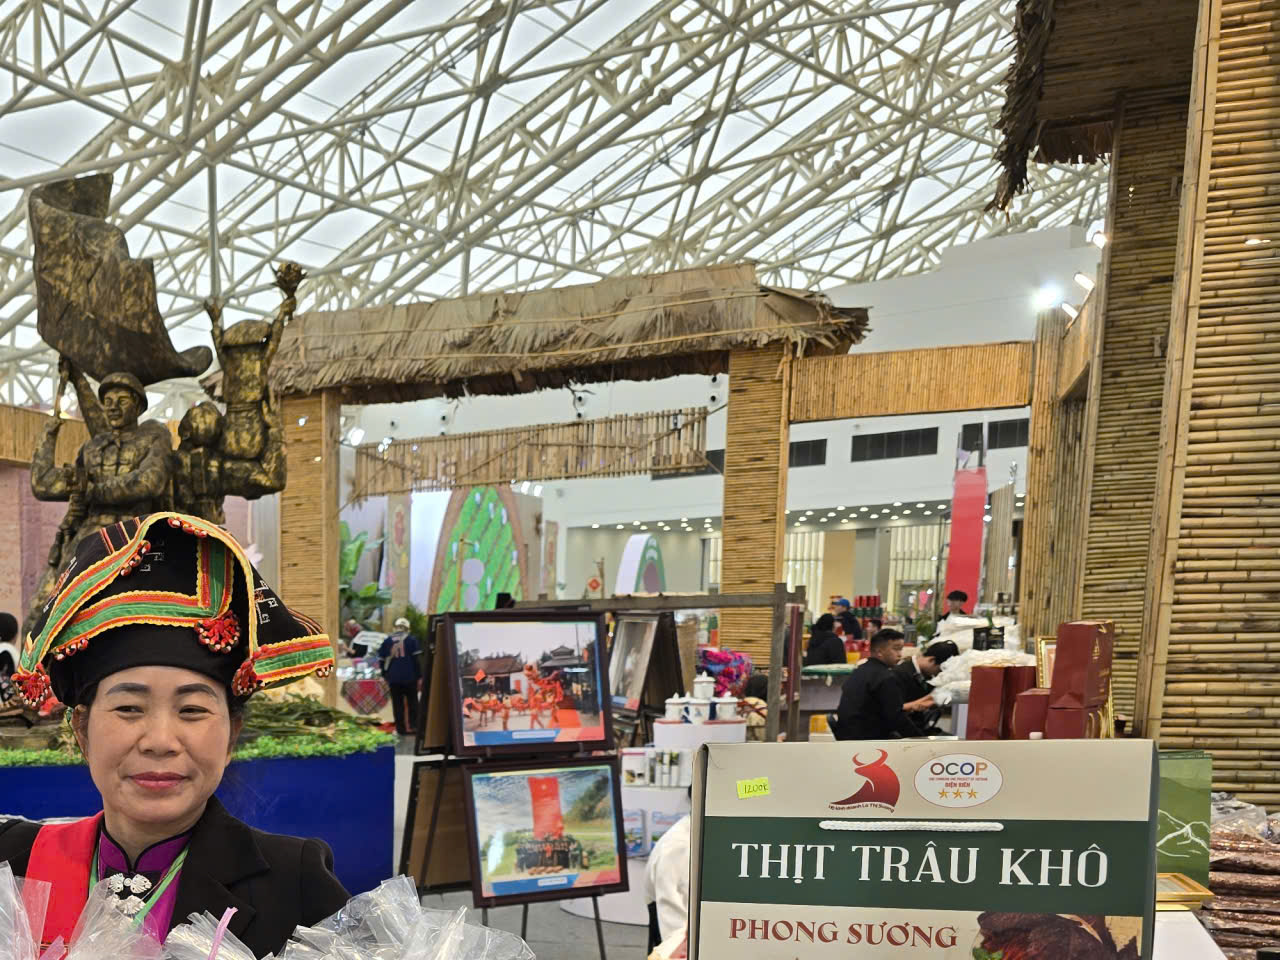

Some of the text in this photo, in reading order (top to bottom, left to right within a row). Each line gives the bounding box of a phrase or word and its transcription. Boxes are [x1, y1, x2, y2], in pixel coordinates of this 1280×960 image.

[930, 762, 988, 776] OCOP
[743, 783, 768, 795] 1200k
[731, 840, 1109, 889] THỊT TRÂU KHÔ
[728, 918, 958, 949] PHONG SƯƠNG
